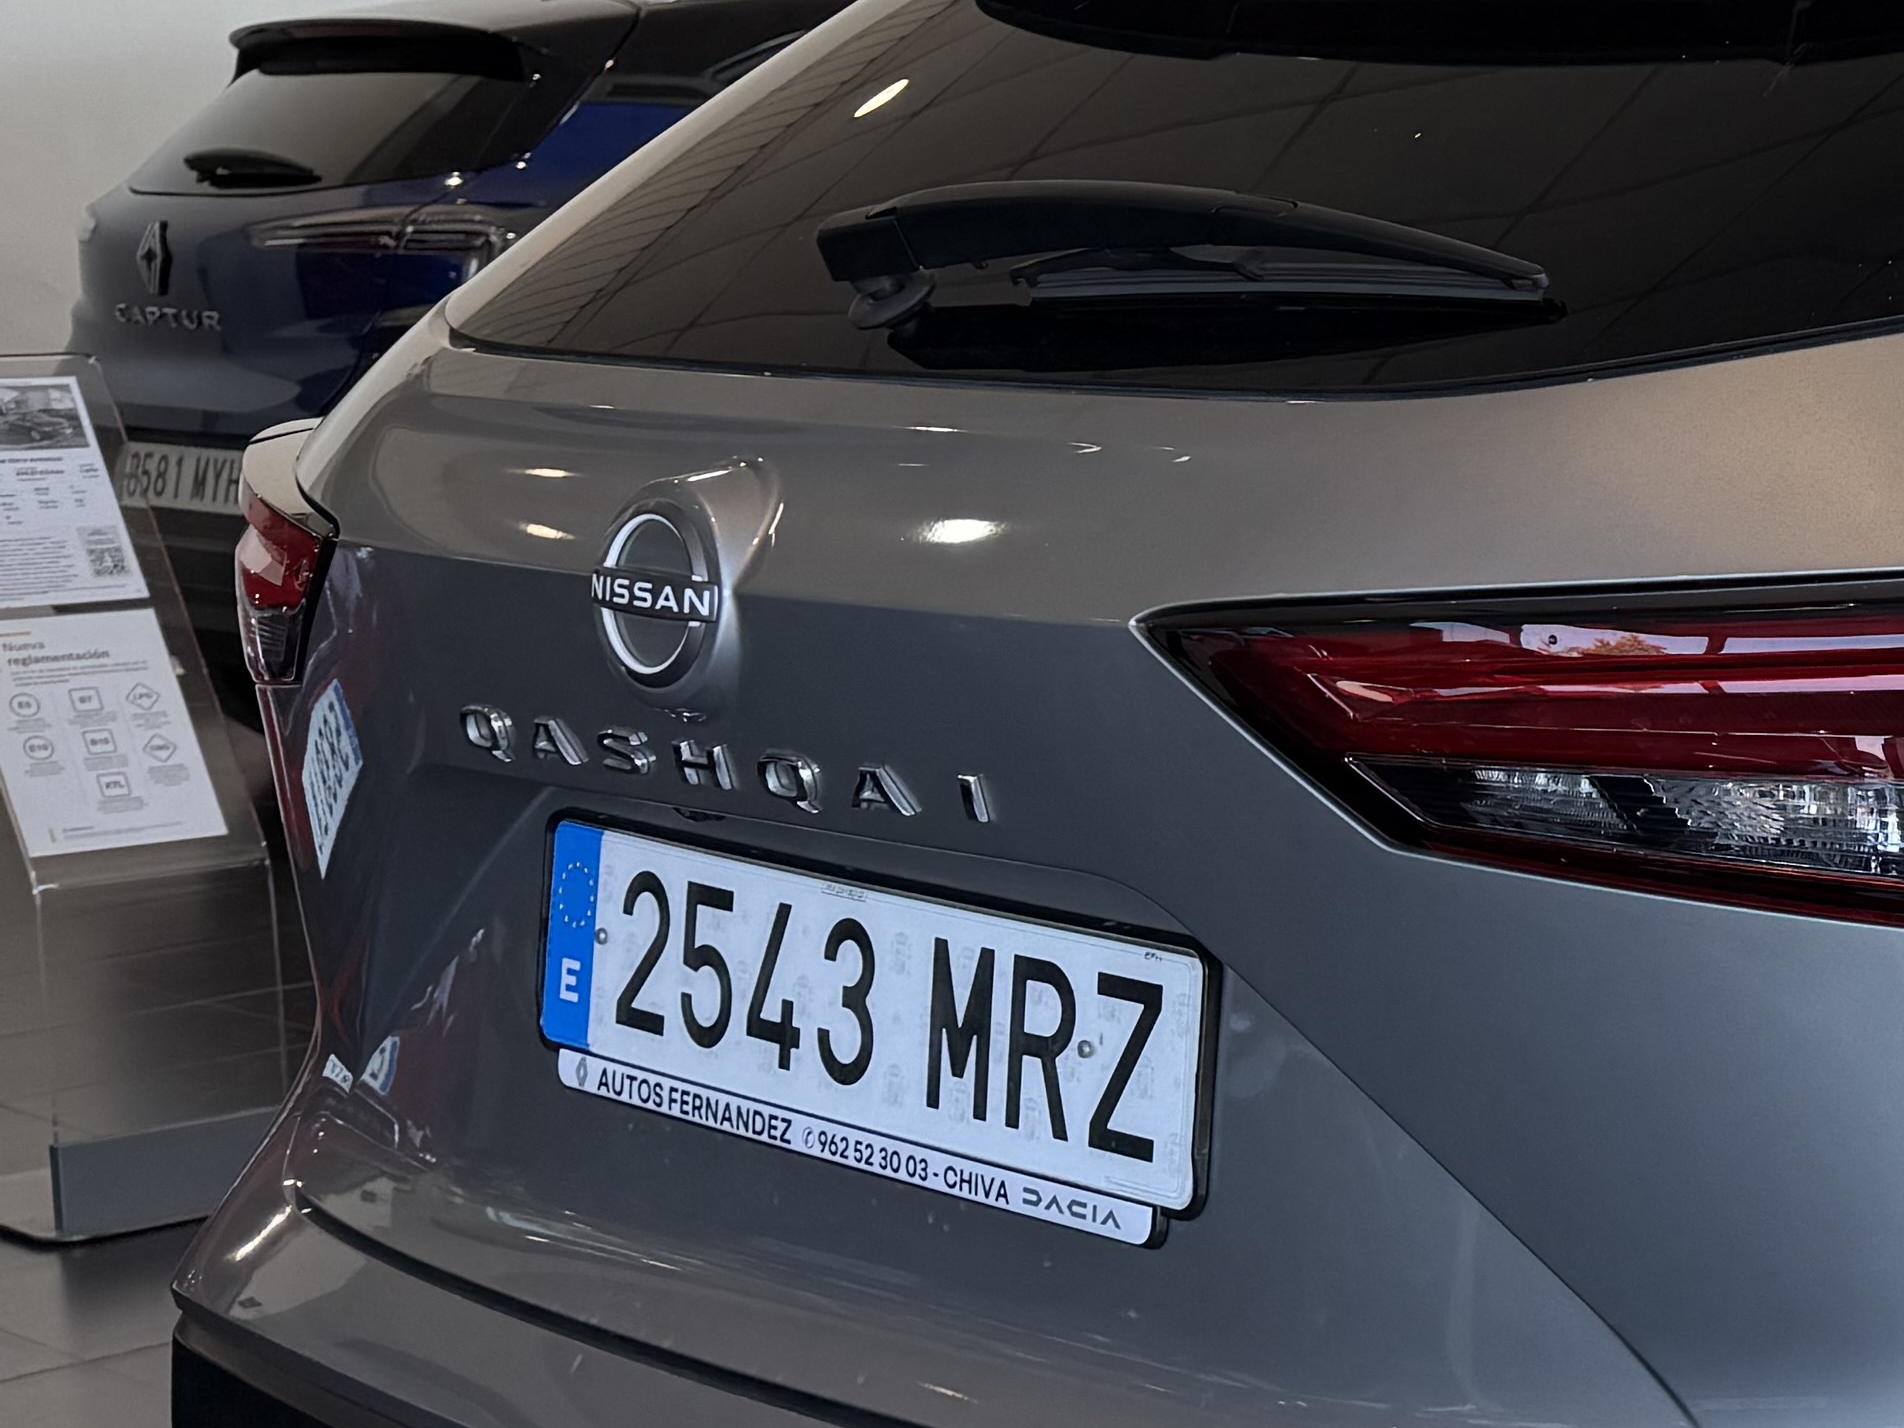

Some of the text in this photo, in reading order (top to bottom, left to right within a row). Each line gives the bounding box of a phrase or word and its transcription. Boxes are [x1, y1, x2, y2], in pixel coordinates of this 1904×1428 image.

[113, 302, 223, 332] CAPTUR
[591, 573, 711, 616] NISSAN
[459, 704, 998, 825] QASHQAI
[558, 958, 581, 1003] E
[615, 871, 1165, 1163] 2543 MRZ
[597, 1067, 664, 1108] AUTOS
[668, 1087, 793, 1145] FERNANDEZ
[817, 1130, 850, 1160] 962
[853, 1141, 875, 1167] 52
[878, 1148, 901, 1174] 30
[905, 1155, 929, 1181] 03
[943, 1165, 1010, 1205] CHIVA
[1022, 1187, 1121, 1230] DACIA
